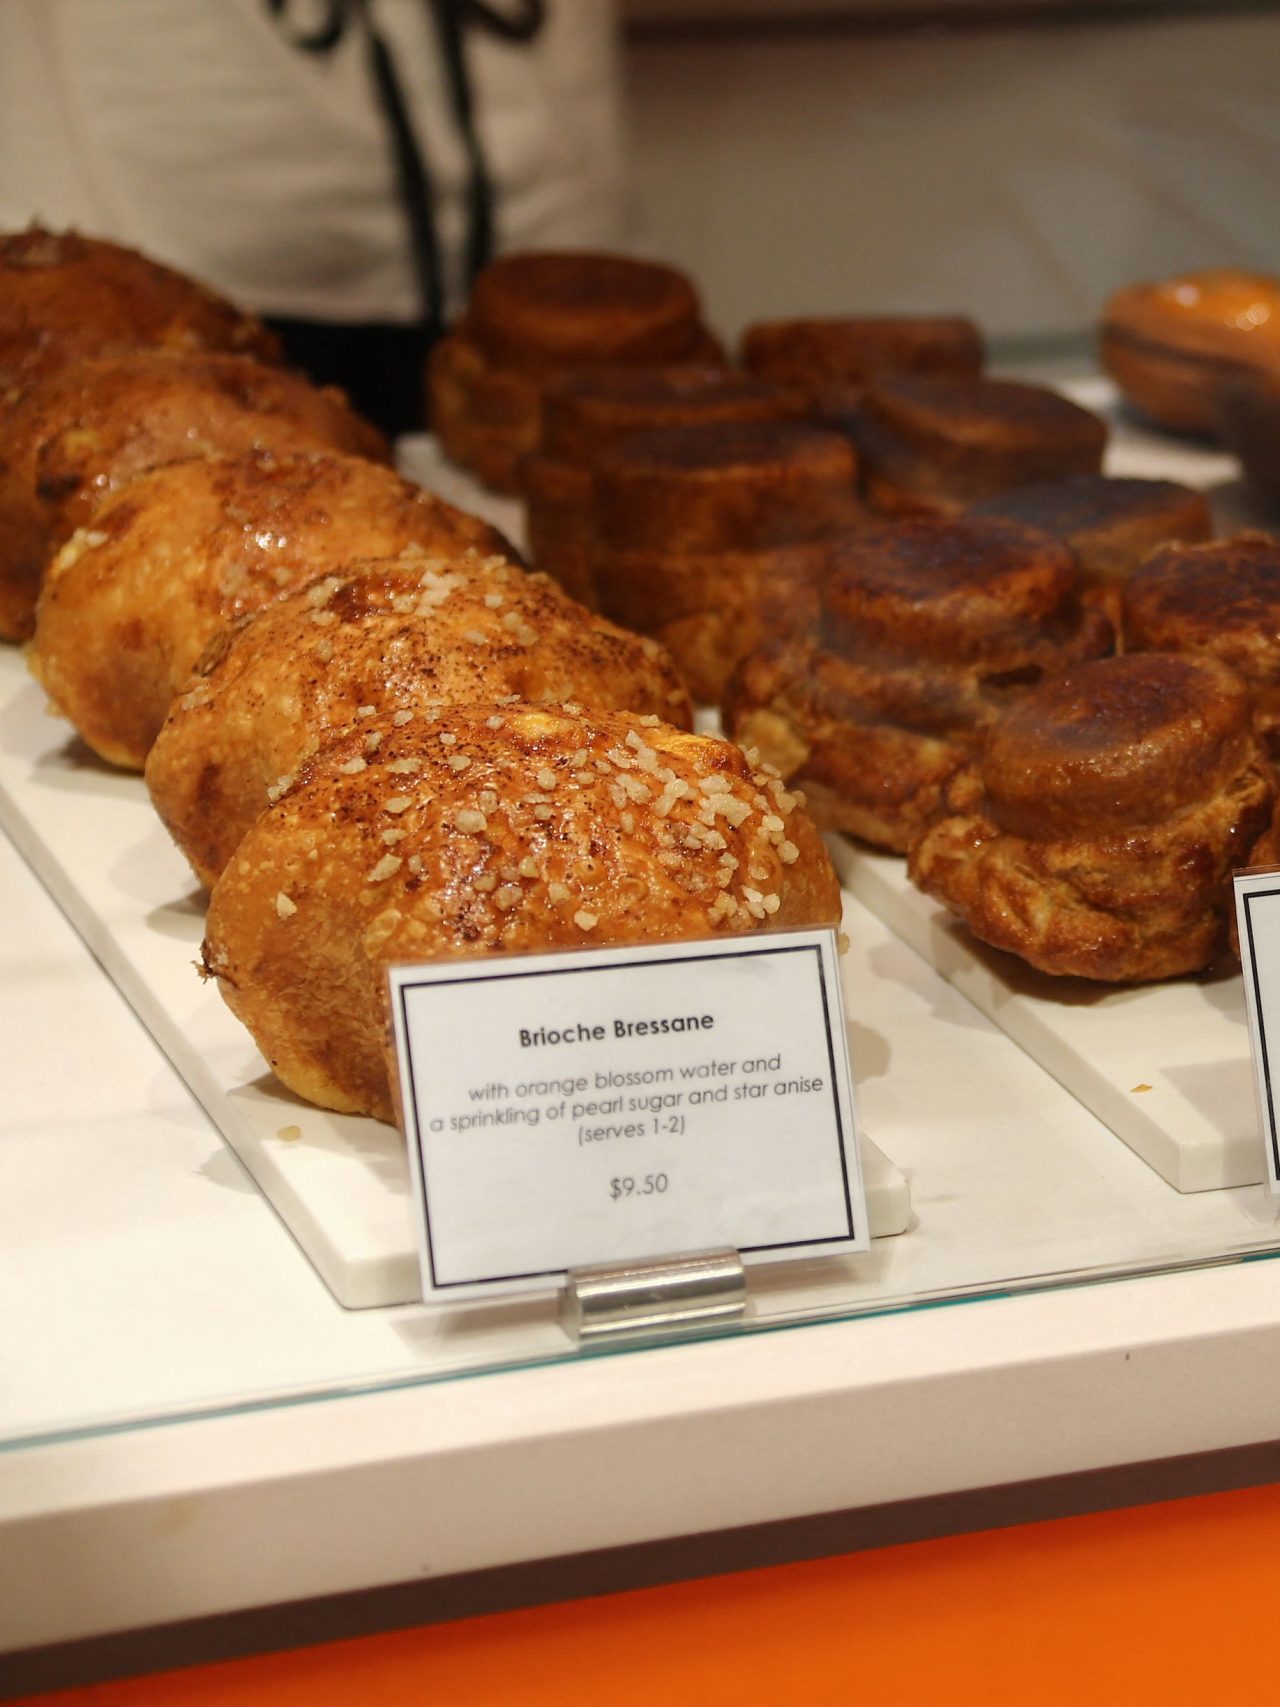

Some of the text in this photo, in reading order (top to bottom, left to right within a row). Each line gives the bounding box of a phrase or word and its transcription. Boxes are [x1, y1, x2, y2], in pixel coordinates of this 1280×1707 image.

[519, 1013, 715, 1048] Brioche Bressane
[468, 1054, 782, 1101] with orange blossom water and
[430, 1076, 823, 1133] a sprinkling of pearl sugar and star anise
[609, 1173, 668, 1200] $9.50
